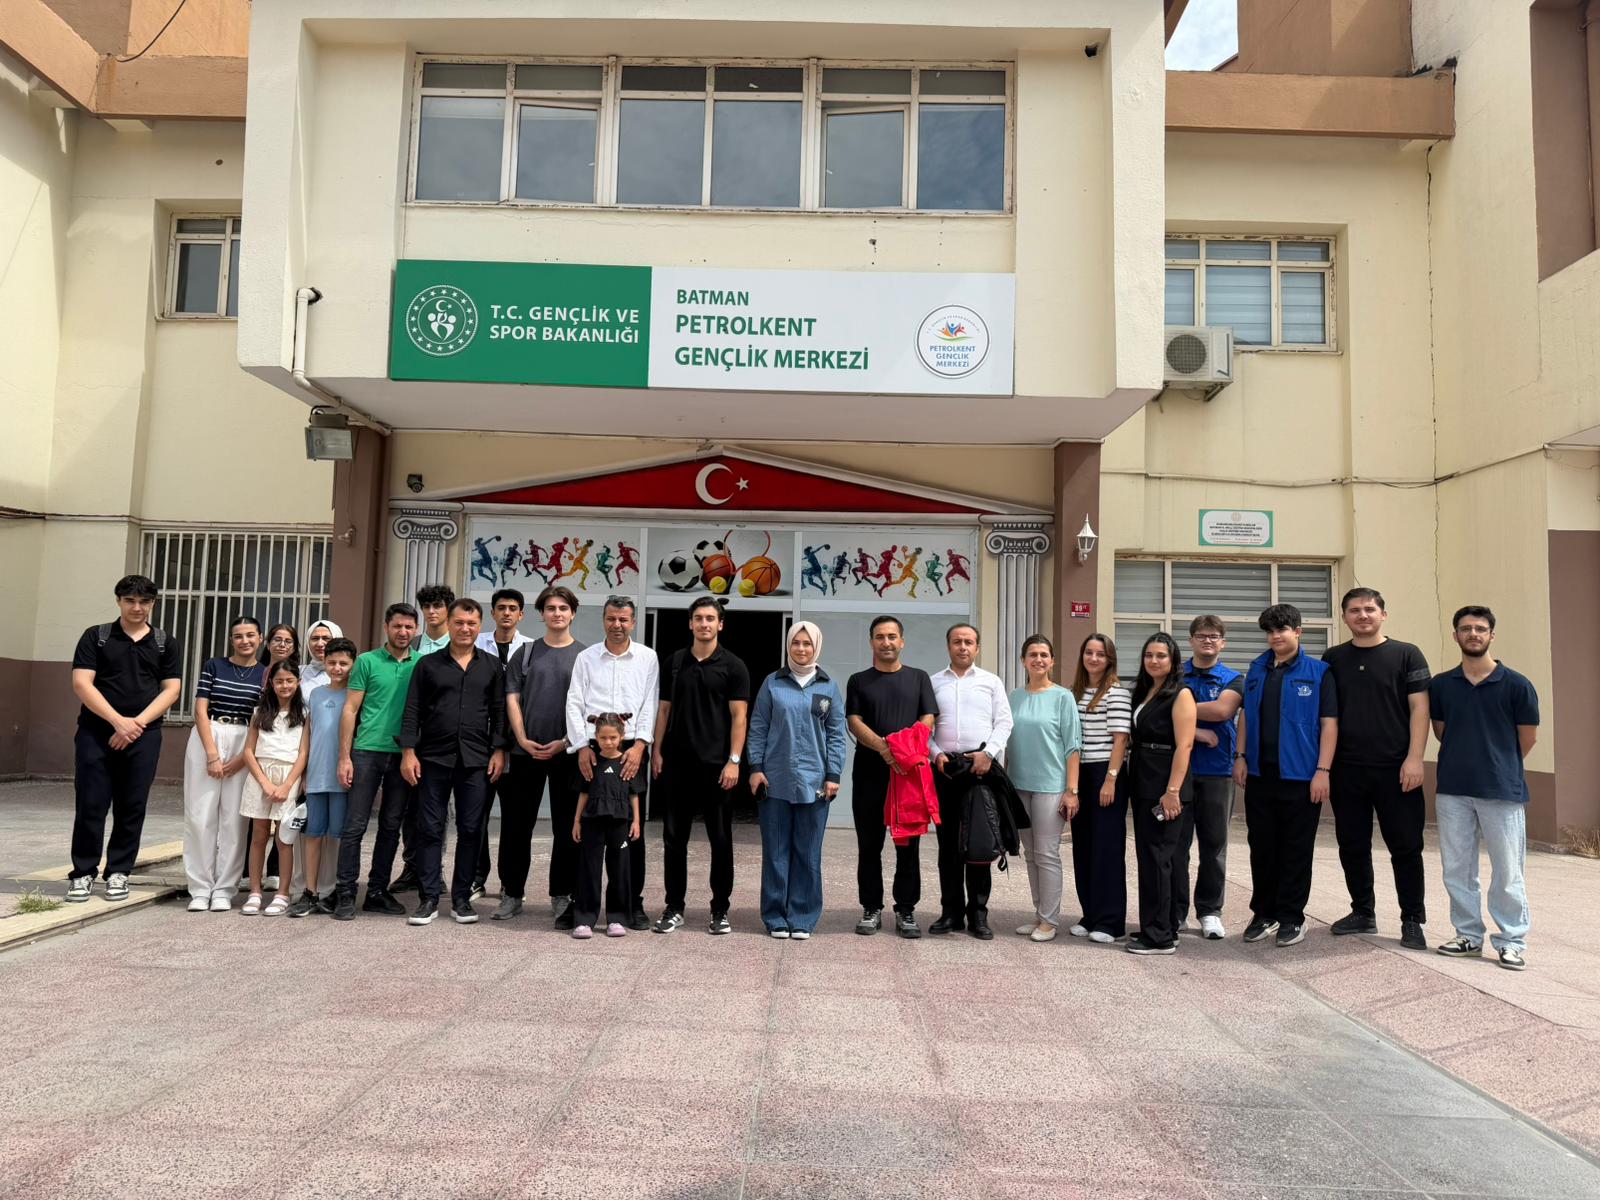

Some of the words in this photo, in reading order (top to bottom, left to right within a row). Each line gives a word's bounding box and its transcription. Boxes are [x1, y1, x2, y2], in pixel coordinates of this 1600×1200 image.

[676, 288, 749, 307] BATMAN
[490, 304, 523, 321] T.C.
[529, 305, 610, 326] GENÇLİK
[616, 308, 640, 324] VE
[675, 314, 817, 337] PETROLKENT
[489, 325, 537, 341] SPOR
[542, 326, 639, 344] BAKANLIĞI
[674, 344, 769, 372] GENÇLİK
[773, 346, 870, 371] MERKEZİ
